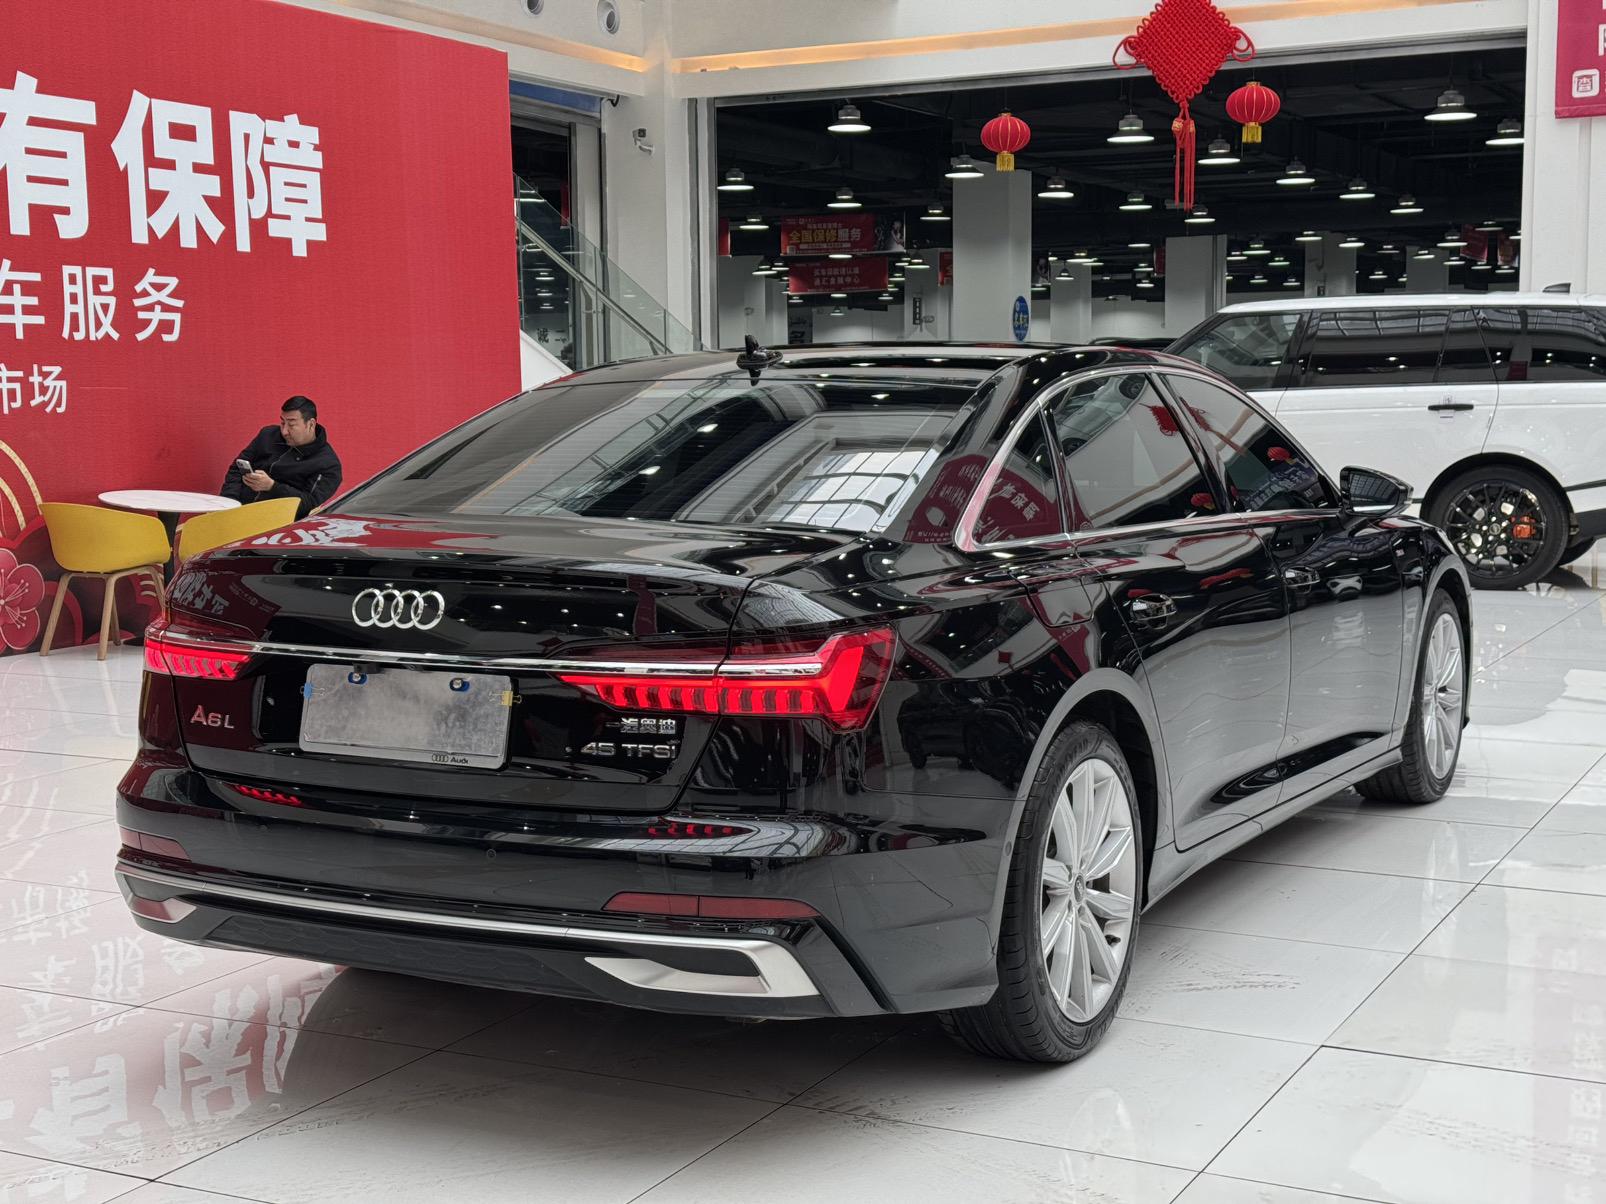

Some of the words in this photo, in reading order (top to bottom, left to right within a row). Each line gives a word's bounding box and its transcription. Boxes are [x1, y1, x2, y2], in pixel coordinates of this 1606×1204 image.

[0, 70, 328, 258] 有保障
[0, 258, 185, 342] 车服务
[0, 363, 67, 414] 市场
[190, 704, 234, 729] A6L
[450, 756, 470, 765] Audi
[580, 742, 616, 756] 45
